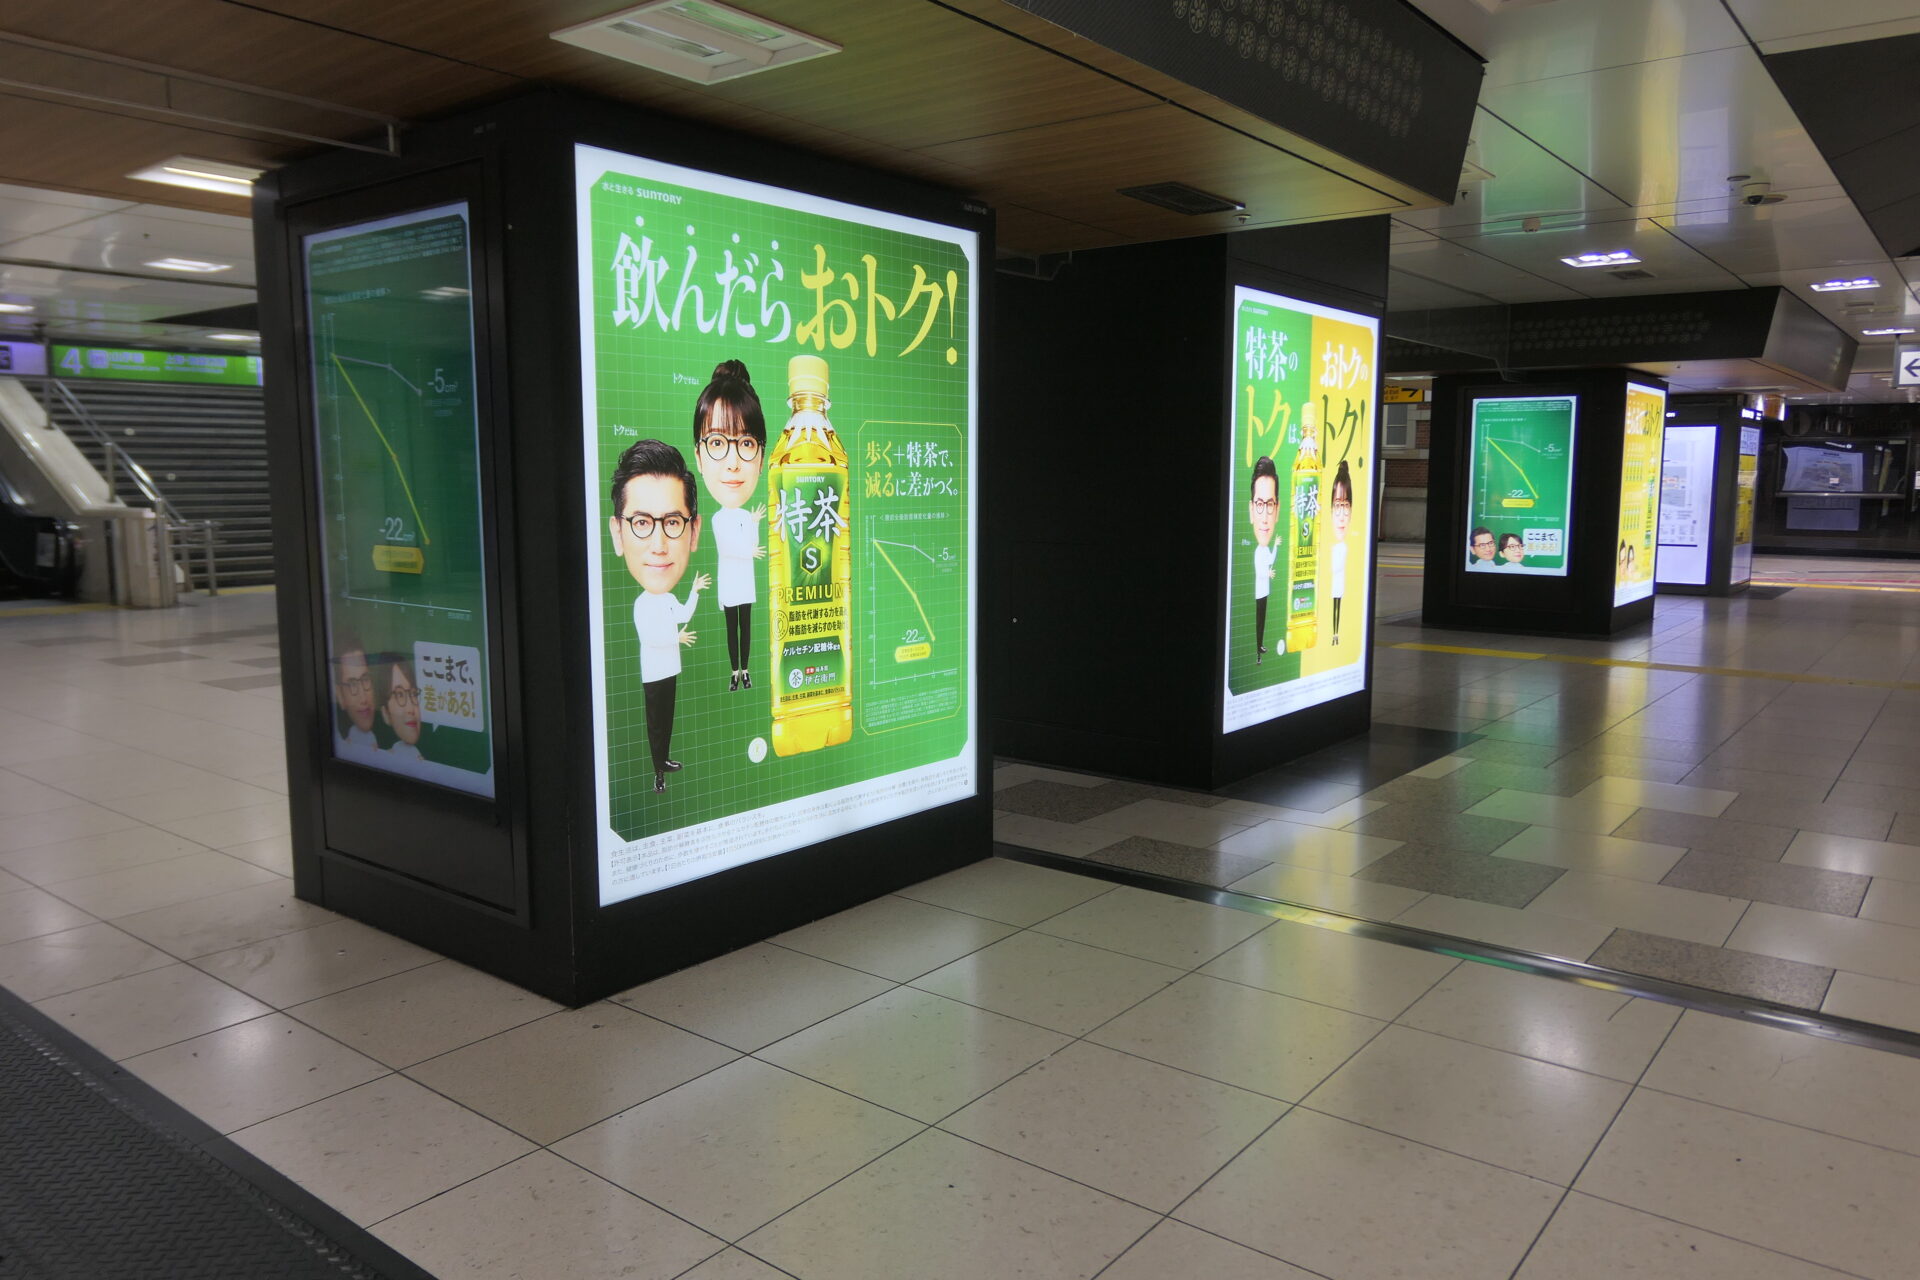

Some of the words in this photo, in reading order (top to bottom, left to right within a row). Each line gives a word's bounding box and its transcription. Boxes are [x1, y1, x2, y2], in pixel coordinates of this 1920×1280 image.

[636, 187, 682, 205] SUNTORY
[1245, 326, 1299, 383] 特茶の
[1320, 341, 1369, 390] おトクの
[773, 486, 848, 543] 特茶
[1294, 485, 1321, 520] 特茶
[805, 547, 818, 569] S
[422, 655, 474, 685] ここまで、
[423, 684, 476, 718] 差がある!
